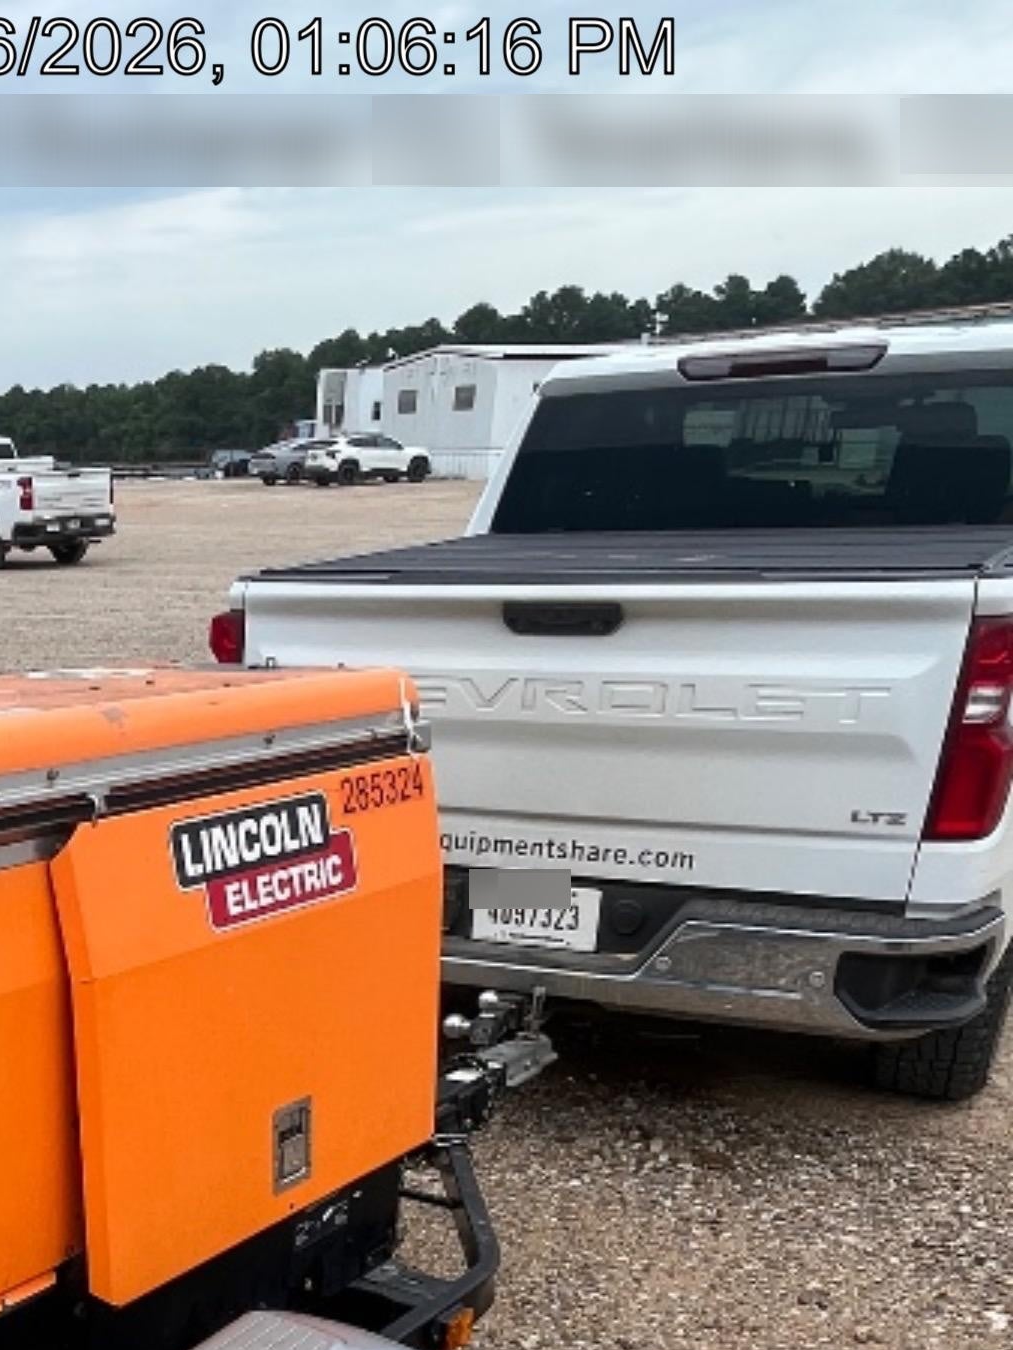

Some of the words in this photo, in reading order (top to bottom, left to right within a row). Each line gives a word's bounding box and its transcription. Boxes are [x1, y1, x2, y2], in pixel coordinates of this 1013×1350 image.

[340, 763, 424, 814] 285324
[181, 803, 324, 877] LINCOLN
[850, 809, 908, 826] LTZ
[439, 830, 694, 870] quipmentshare.com
[224, 854, 343, 916] ELECTRIC
